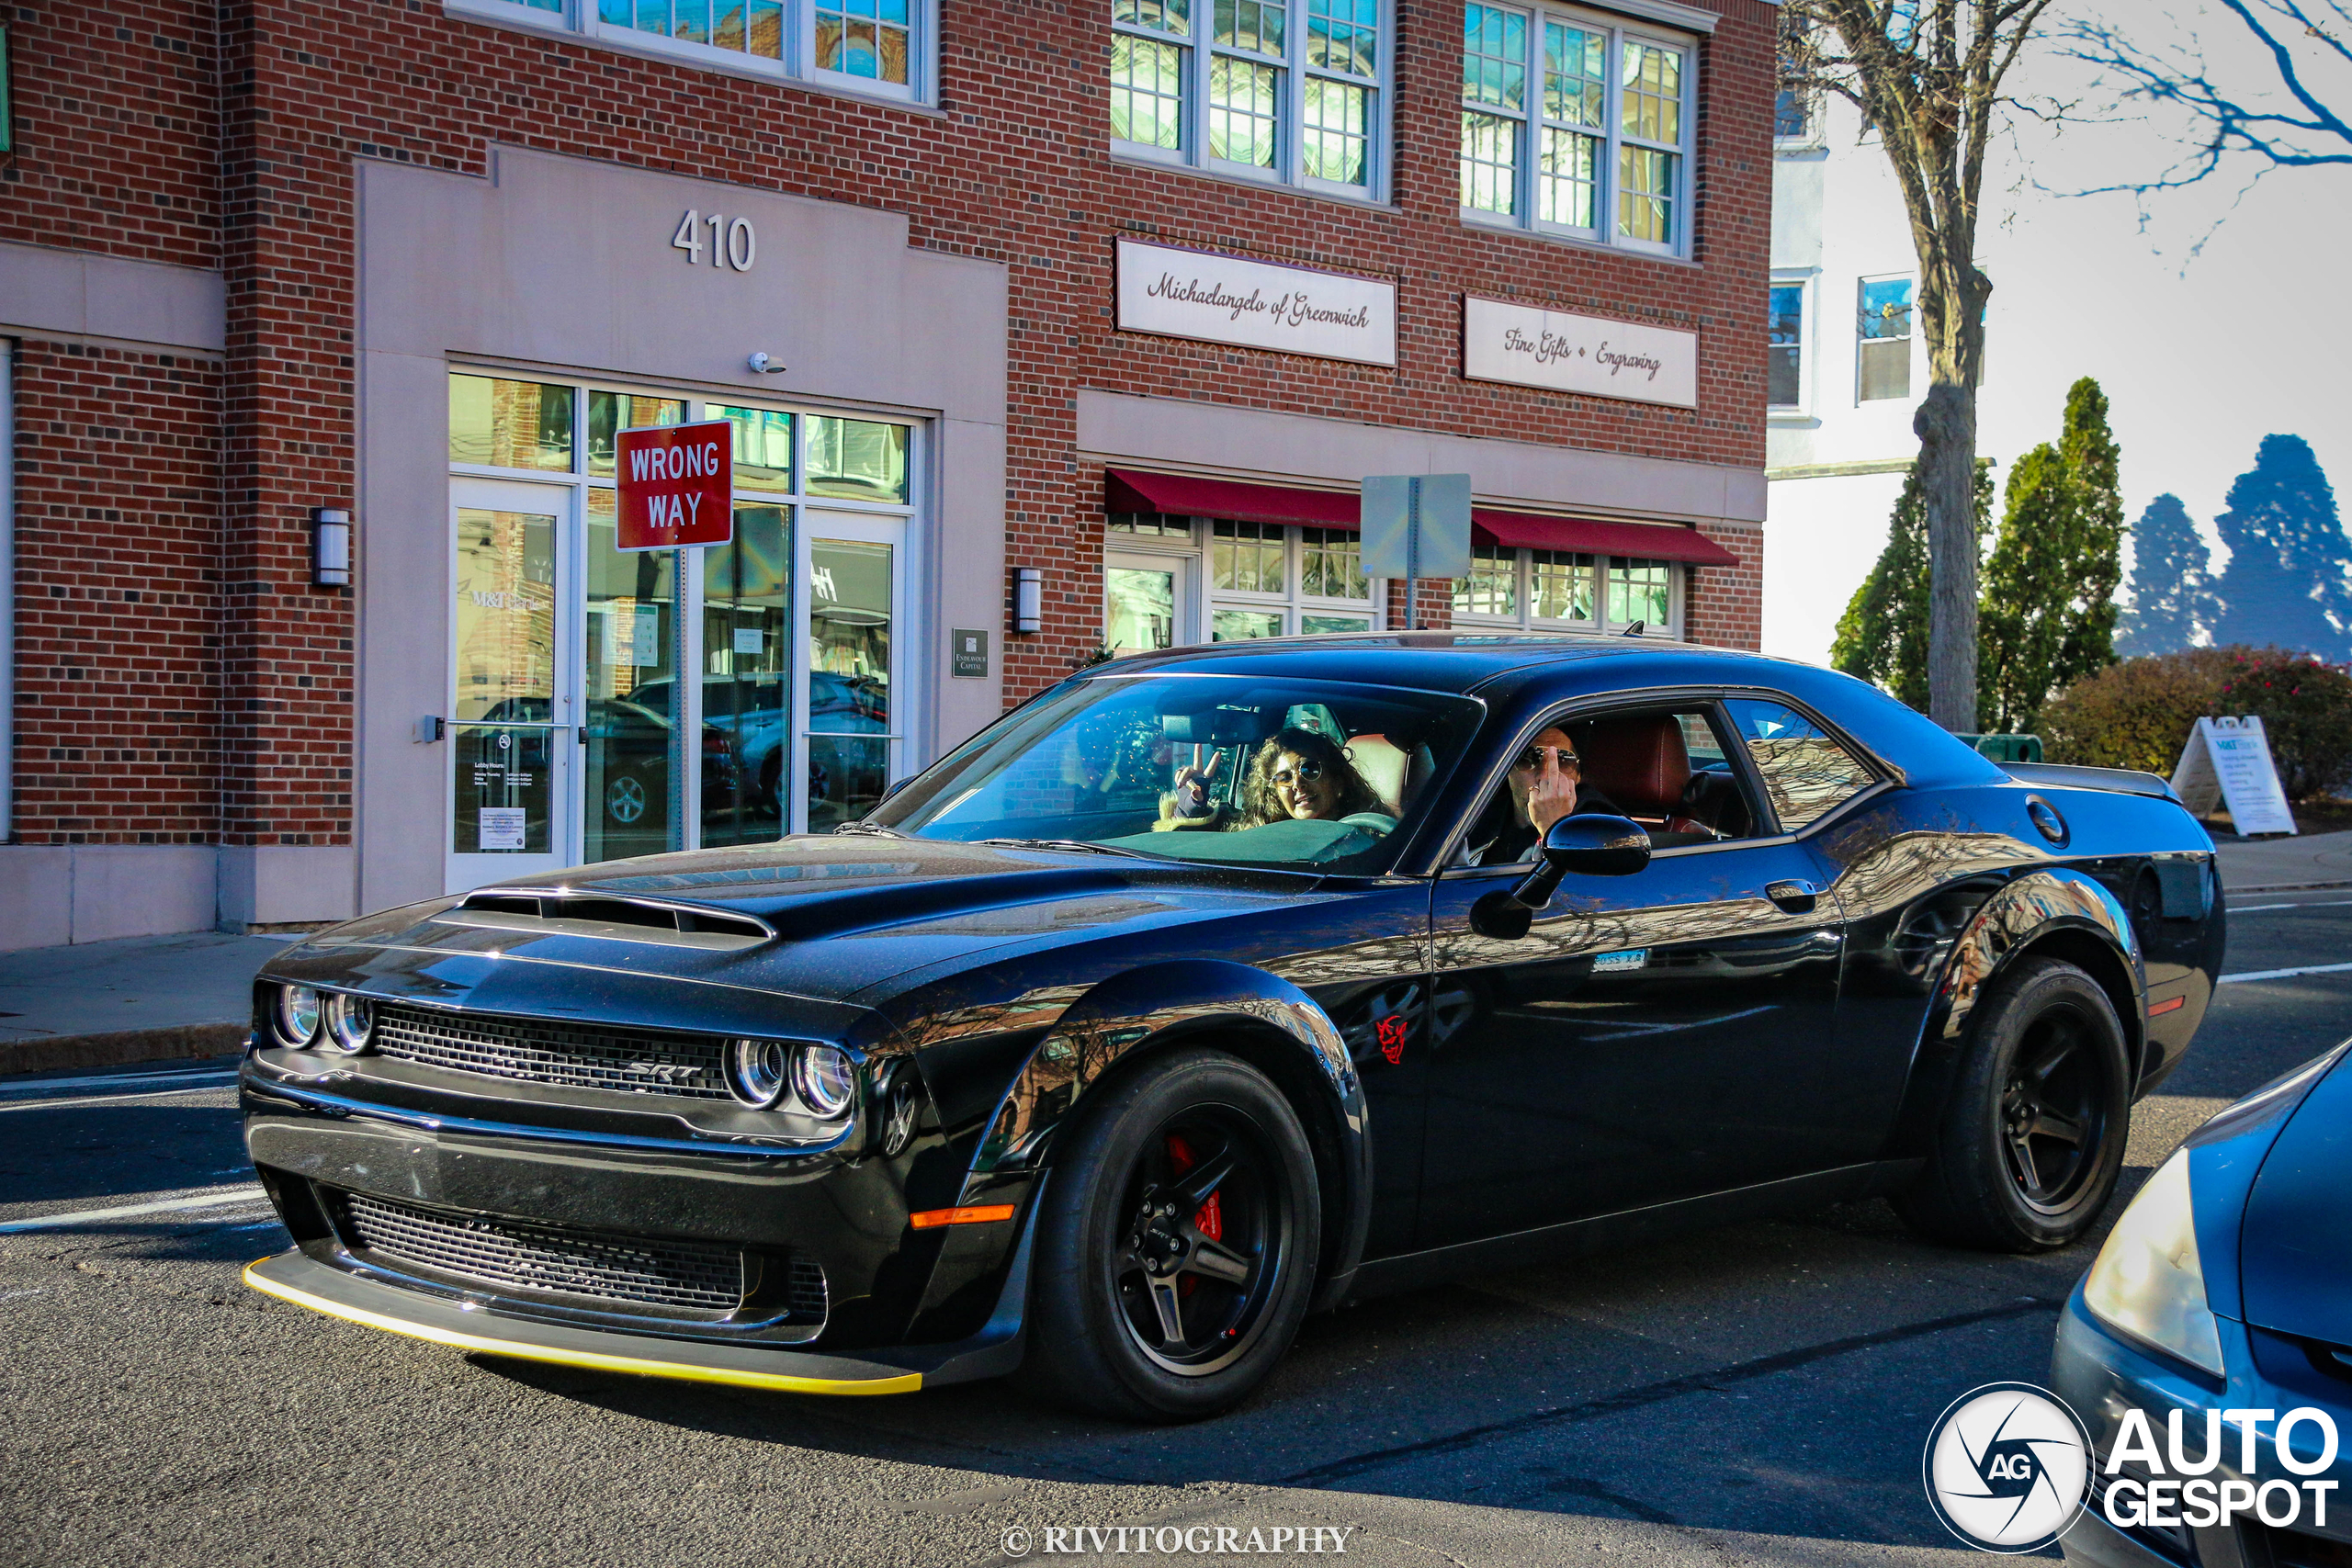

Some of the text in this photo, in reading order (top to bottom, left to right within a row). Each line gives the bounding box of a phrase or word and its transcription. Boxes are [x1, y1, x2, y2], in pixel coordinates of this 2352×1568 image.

[673, 209, 755, 272] 410
[1148, 272, 1370, 327] Michaelangelo of Greenwich
[1505, 327, 1662, 381] Fine Gifts Engraving
[630, 442, 718, 482] WRONG
[648, 492, 703, 528] WAY
[471, 590, 505, 608] M&T
[625, 1062, 703, 1081] SRT
